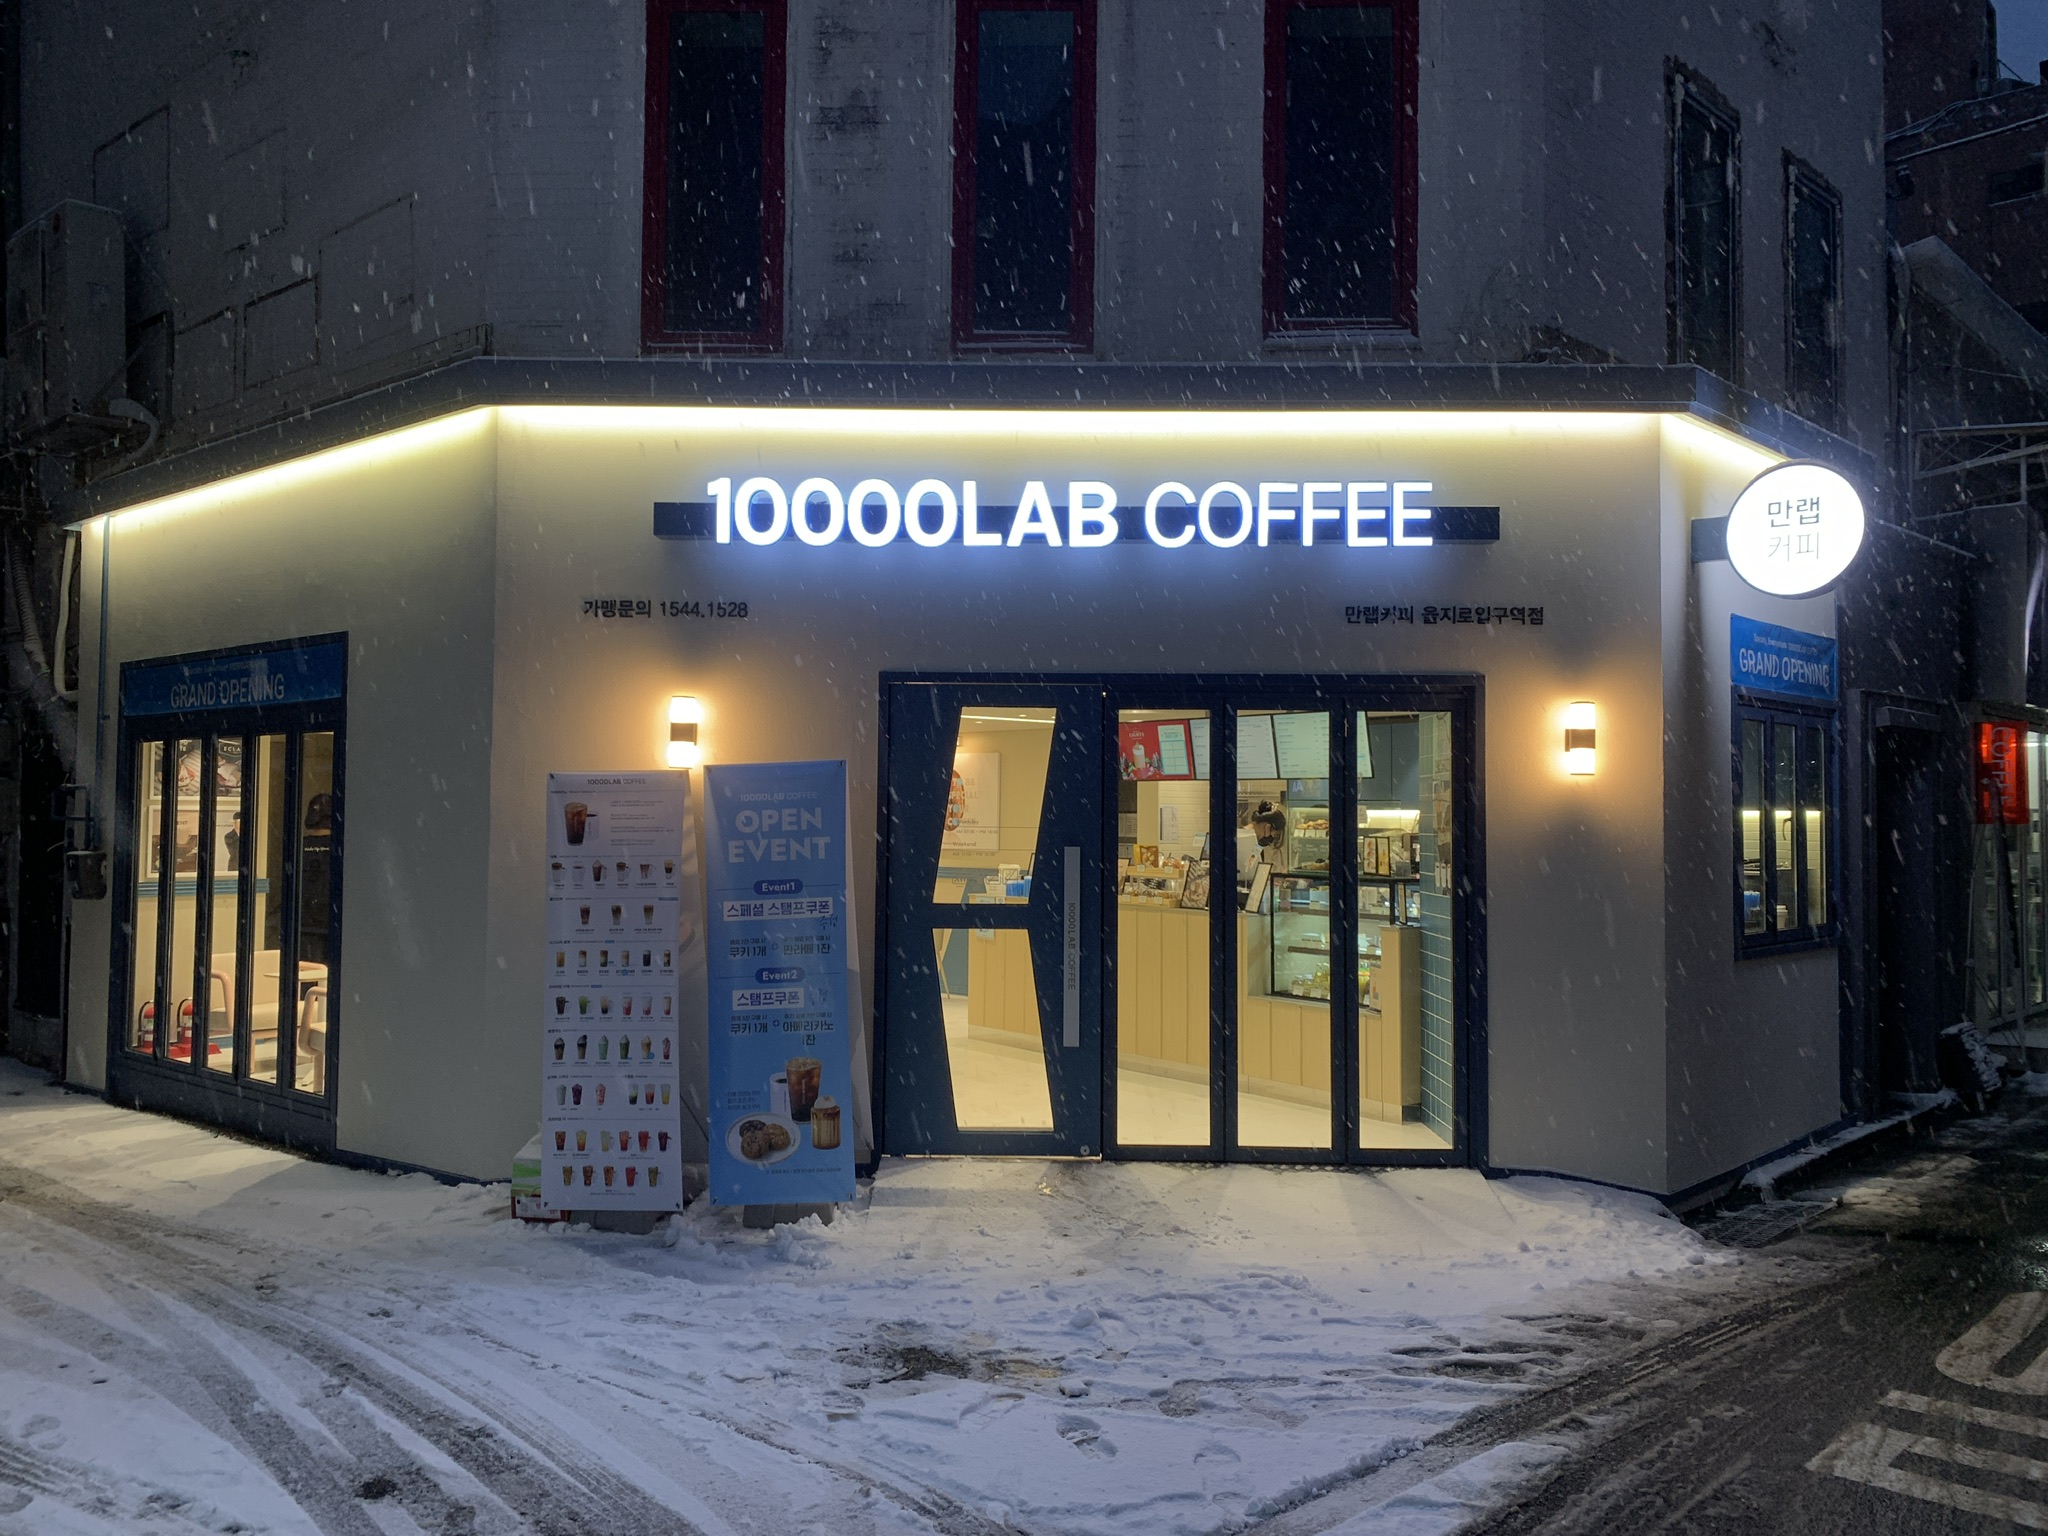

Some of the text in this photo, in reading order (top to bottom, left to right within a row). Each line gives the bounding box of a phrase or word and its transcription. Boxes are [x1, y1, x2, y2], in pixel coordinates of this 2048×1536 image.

[706, 476, 1433, 549] 10000LAB COFFEE
[1768, 497, 1819, 527] 만랩
[1768, 532, 1819, 561] 커피
[583, 600, 749, 618] 가맹문의 1544.1528
[1345, 605, 1544, 625] 만랩커피 을지로입구역점
[1740, 647, 1830, 687] GRAND OPENING
[170, 673, 285, 708] GRAND OPENING
[740, 791, 818, 802] 10000LAB COFFEE
[735, 807, 822, 833] OPEN
[728, 836, 831, 863] EVENT
[761, 882, 796, 892] Event1
[727, 900, 830, 918] 스페셜 스탬프쿠폰
[729, 945, 767, 958] 쿠키 1개
[816, 942, 831, 954] 1잔
[762, 970, 798, 981] Event2
[1068, 954, 1076, 991] COFFEE
[736, 990, 800, 1007] 스탬프쿠폰
[730, 1022, 768, 1034] 쿠키 1개
